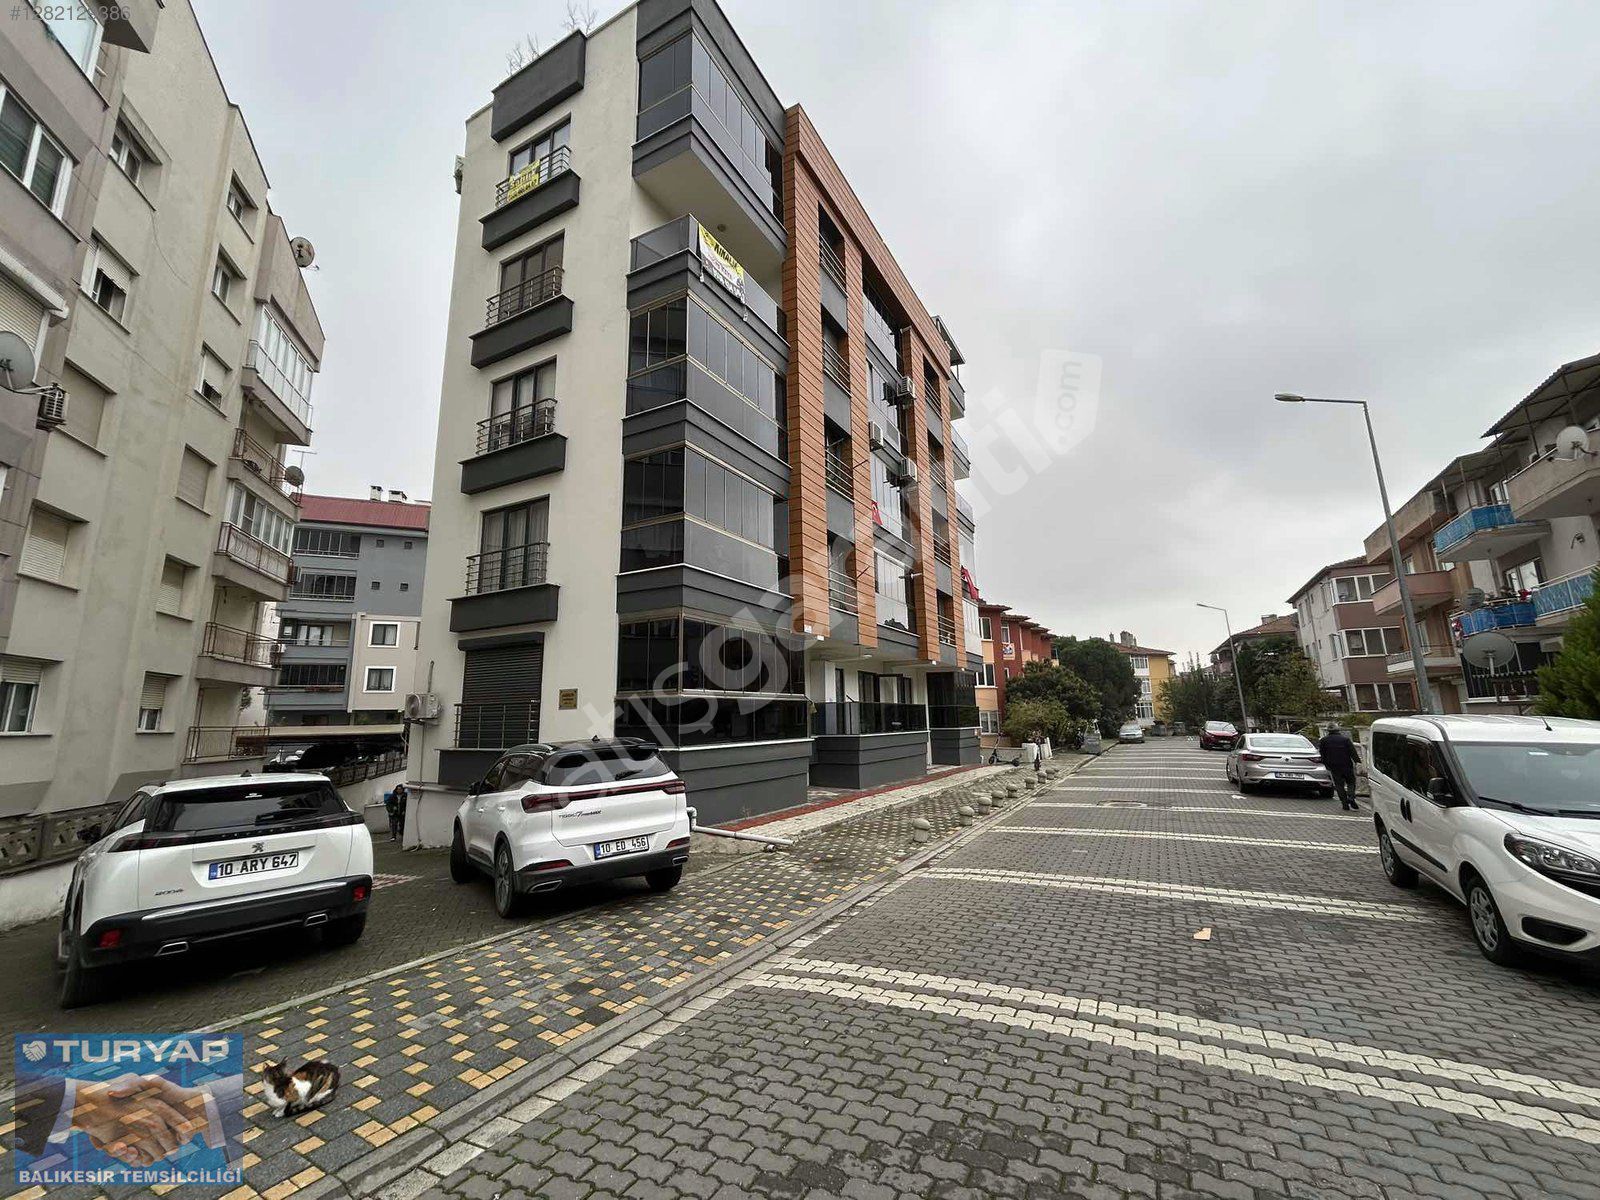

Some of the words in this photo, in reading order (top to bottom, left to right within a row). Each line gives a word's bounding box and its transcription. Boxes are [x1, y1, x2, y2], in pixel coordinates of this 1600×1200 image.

[601, 844, 611, 853] 10
[631, 838, 646, 848] 456
[218, 863, 233, 876] 10
[240, 857, 268, 874] ARY
[271, 854, 297, 868] 647
